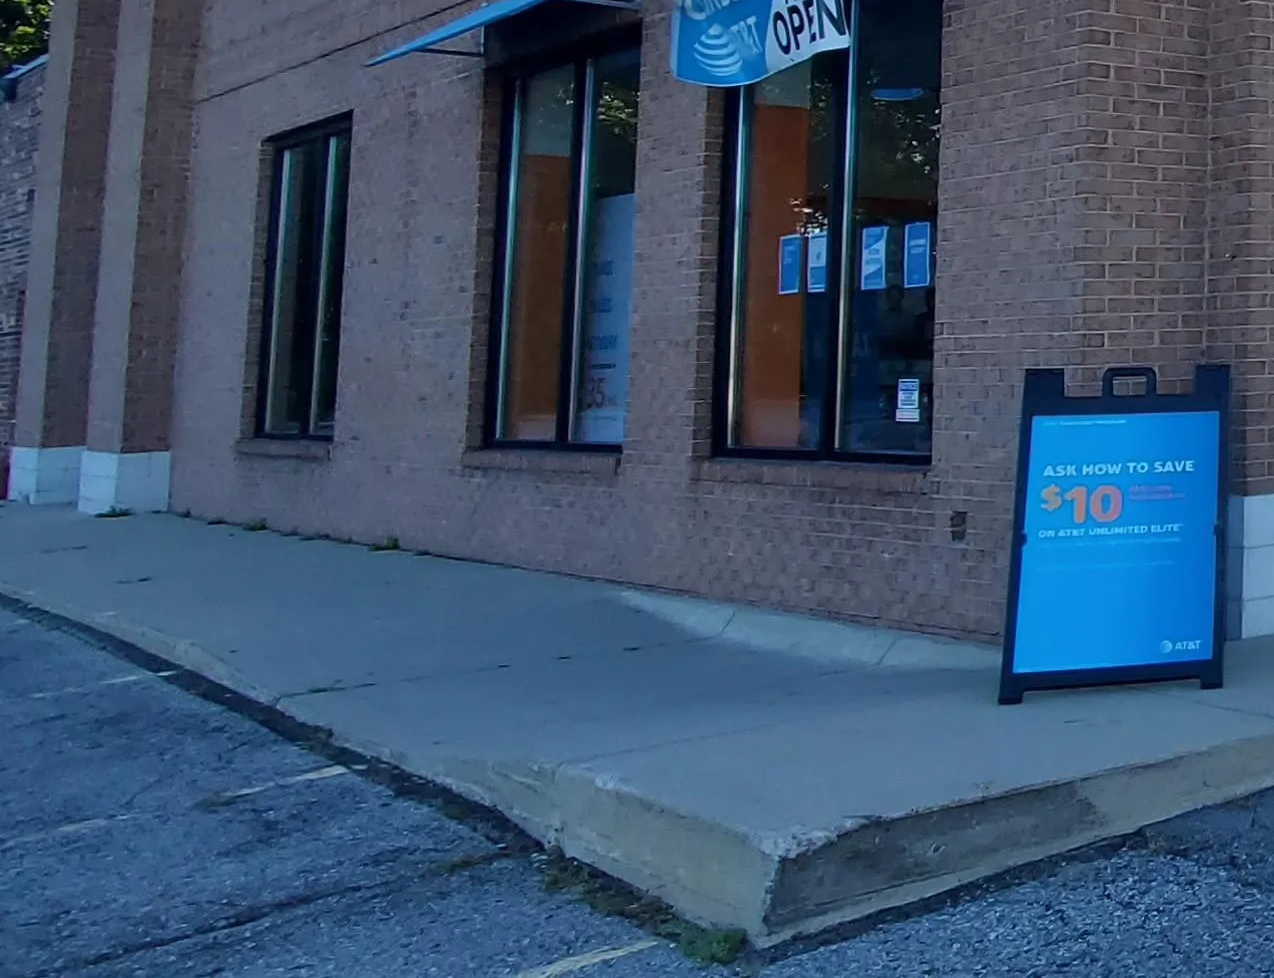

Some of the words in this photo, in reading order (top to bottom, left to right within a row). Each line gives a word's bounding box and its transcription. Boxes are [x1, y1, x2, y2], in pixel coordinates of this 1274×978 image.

[1043, 464, 1077, 477] ASK
[1082, 462, 1122, 476] HOW
[1126, 461, 1149, 474] TO
[1153, 460, 1196, 473] SAVE
[1040, 484, 1123, 524] $10
[1038, 528, 1055, 538] ON
[1058, 527, 1086, 537] AT&T
[1088, 525, 1149, 536] UNLIMITED
[1175, 639, 1201, 651] AT&T
